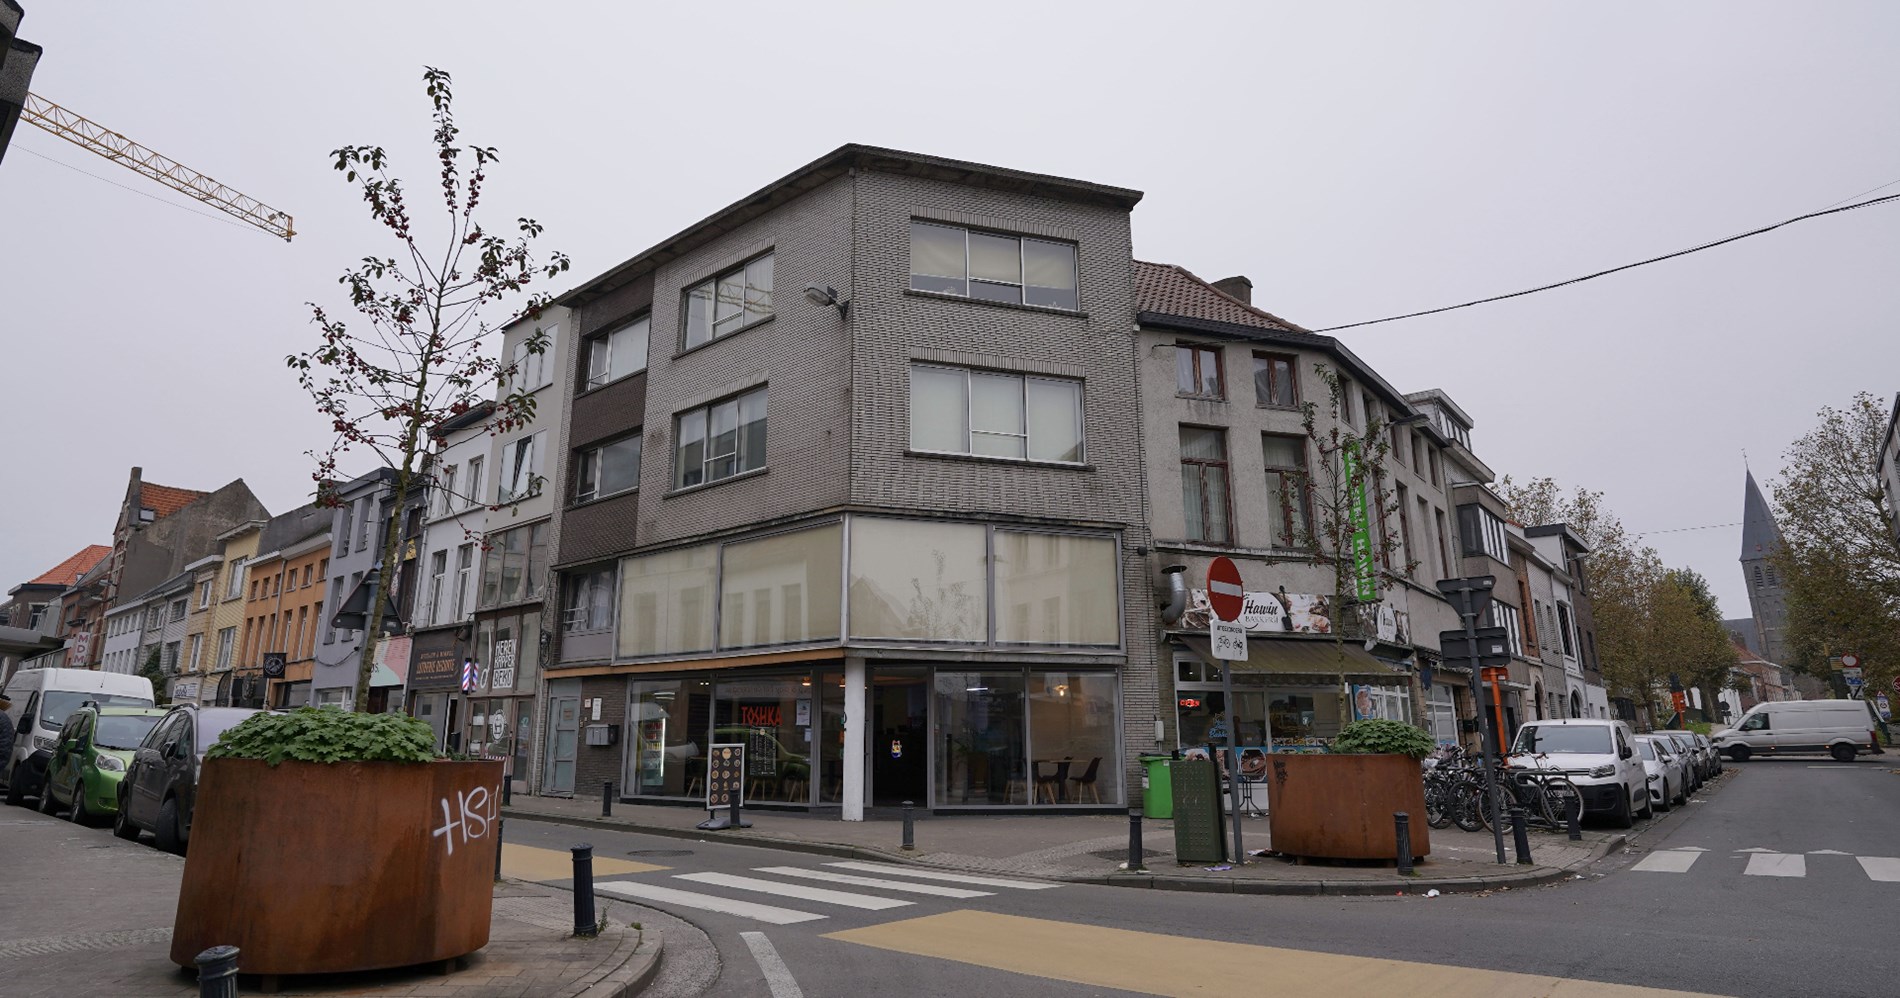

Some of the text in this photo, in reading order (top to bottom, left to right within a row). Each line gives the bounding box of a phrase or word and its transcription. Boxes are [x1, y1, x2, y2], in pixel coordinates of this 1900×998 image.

[1243, 600, 1279, 615] Hawin
[1245, 615, 1279, 624] BAKKERIJ
[73, 634, 89, 663] MDM
[495, 639, 517, 656] HEREN
[494, 654, 515, 669] KAPPER
[493, 668, 514, 688] BEKO
[741, 706, 784, 726] TOSHKA
